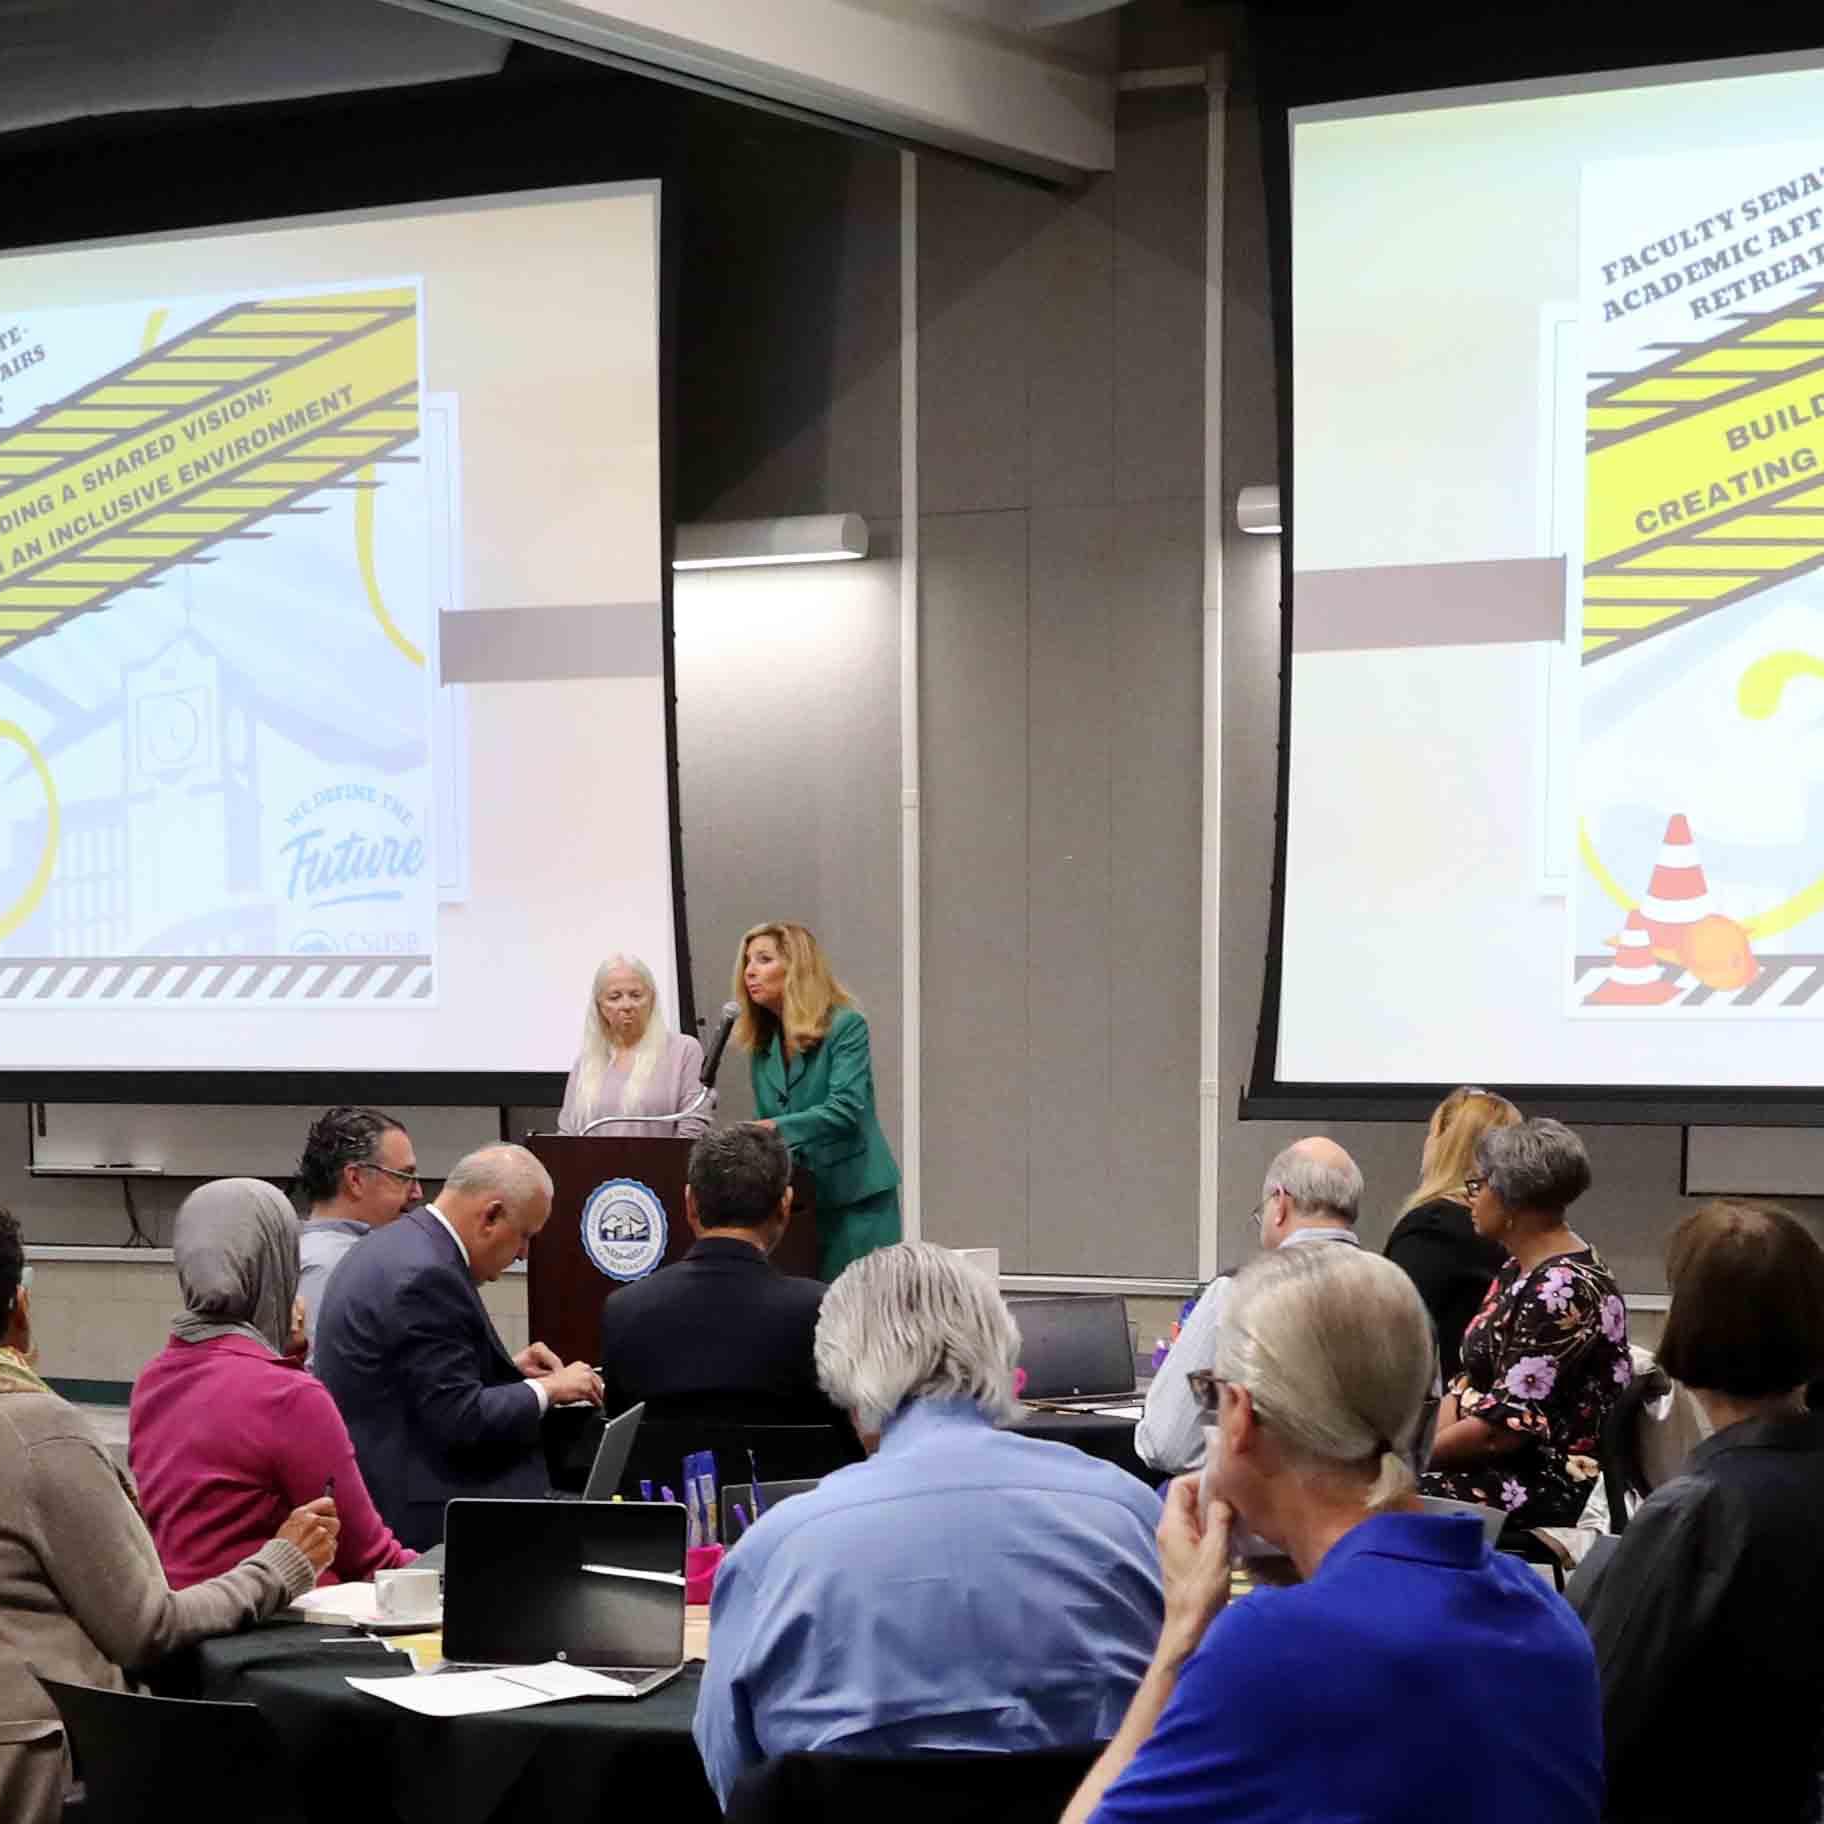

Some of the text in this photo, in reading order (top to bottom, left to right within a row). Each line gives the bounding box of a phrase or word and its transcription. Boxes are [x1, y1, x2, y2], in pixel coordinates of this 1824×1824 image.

[1601, 208, 1735, 285] FACULTY
[1602, 235, 1763, 322] ACADEMIC
[11, 539, 43, 568] AN
[49, 477, 172, 548] INCLUSIVE
[177, 385, 354, 484] ENVIRONMENT
[61, 482, 77, 504] A
[81, 434, 176, 491] SHARED
[181, 390, 273, 442] VISION:
[1634, 446, 1819, 536] CREATING
[280, 827, 424, 903] Future
